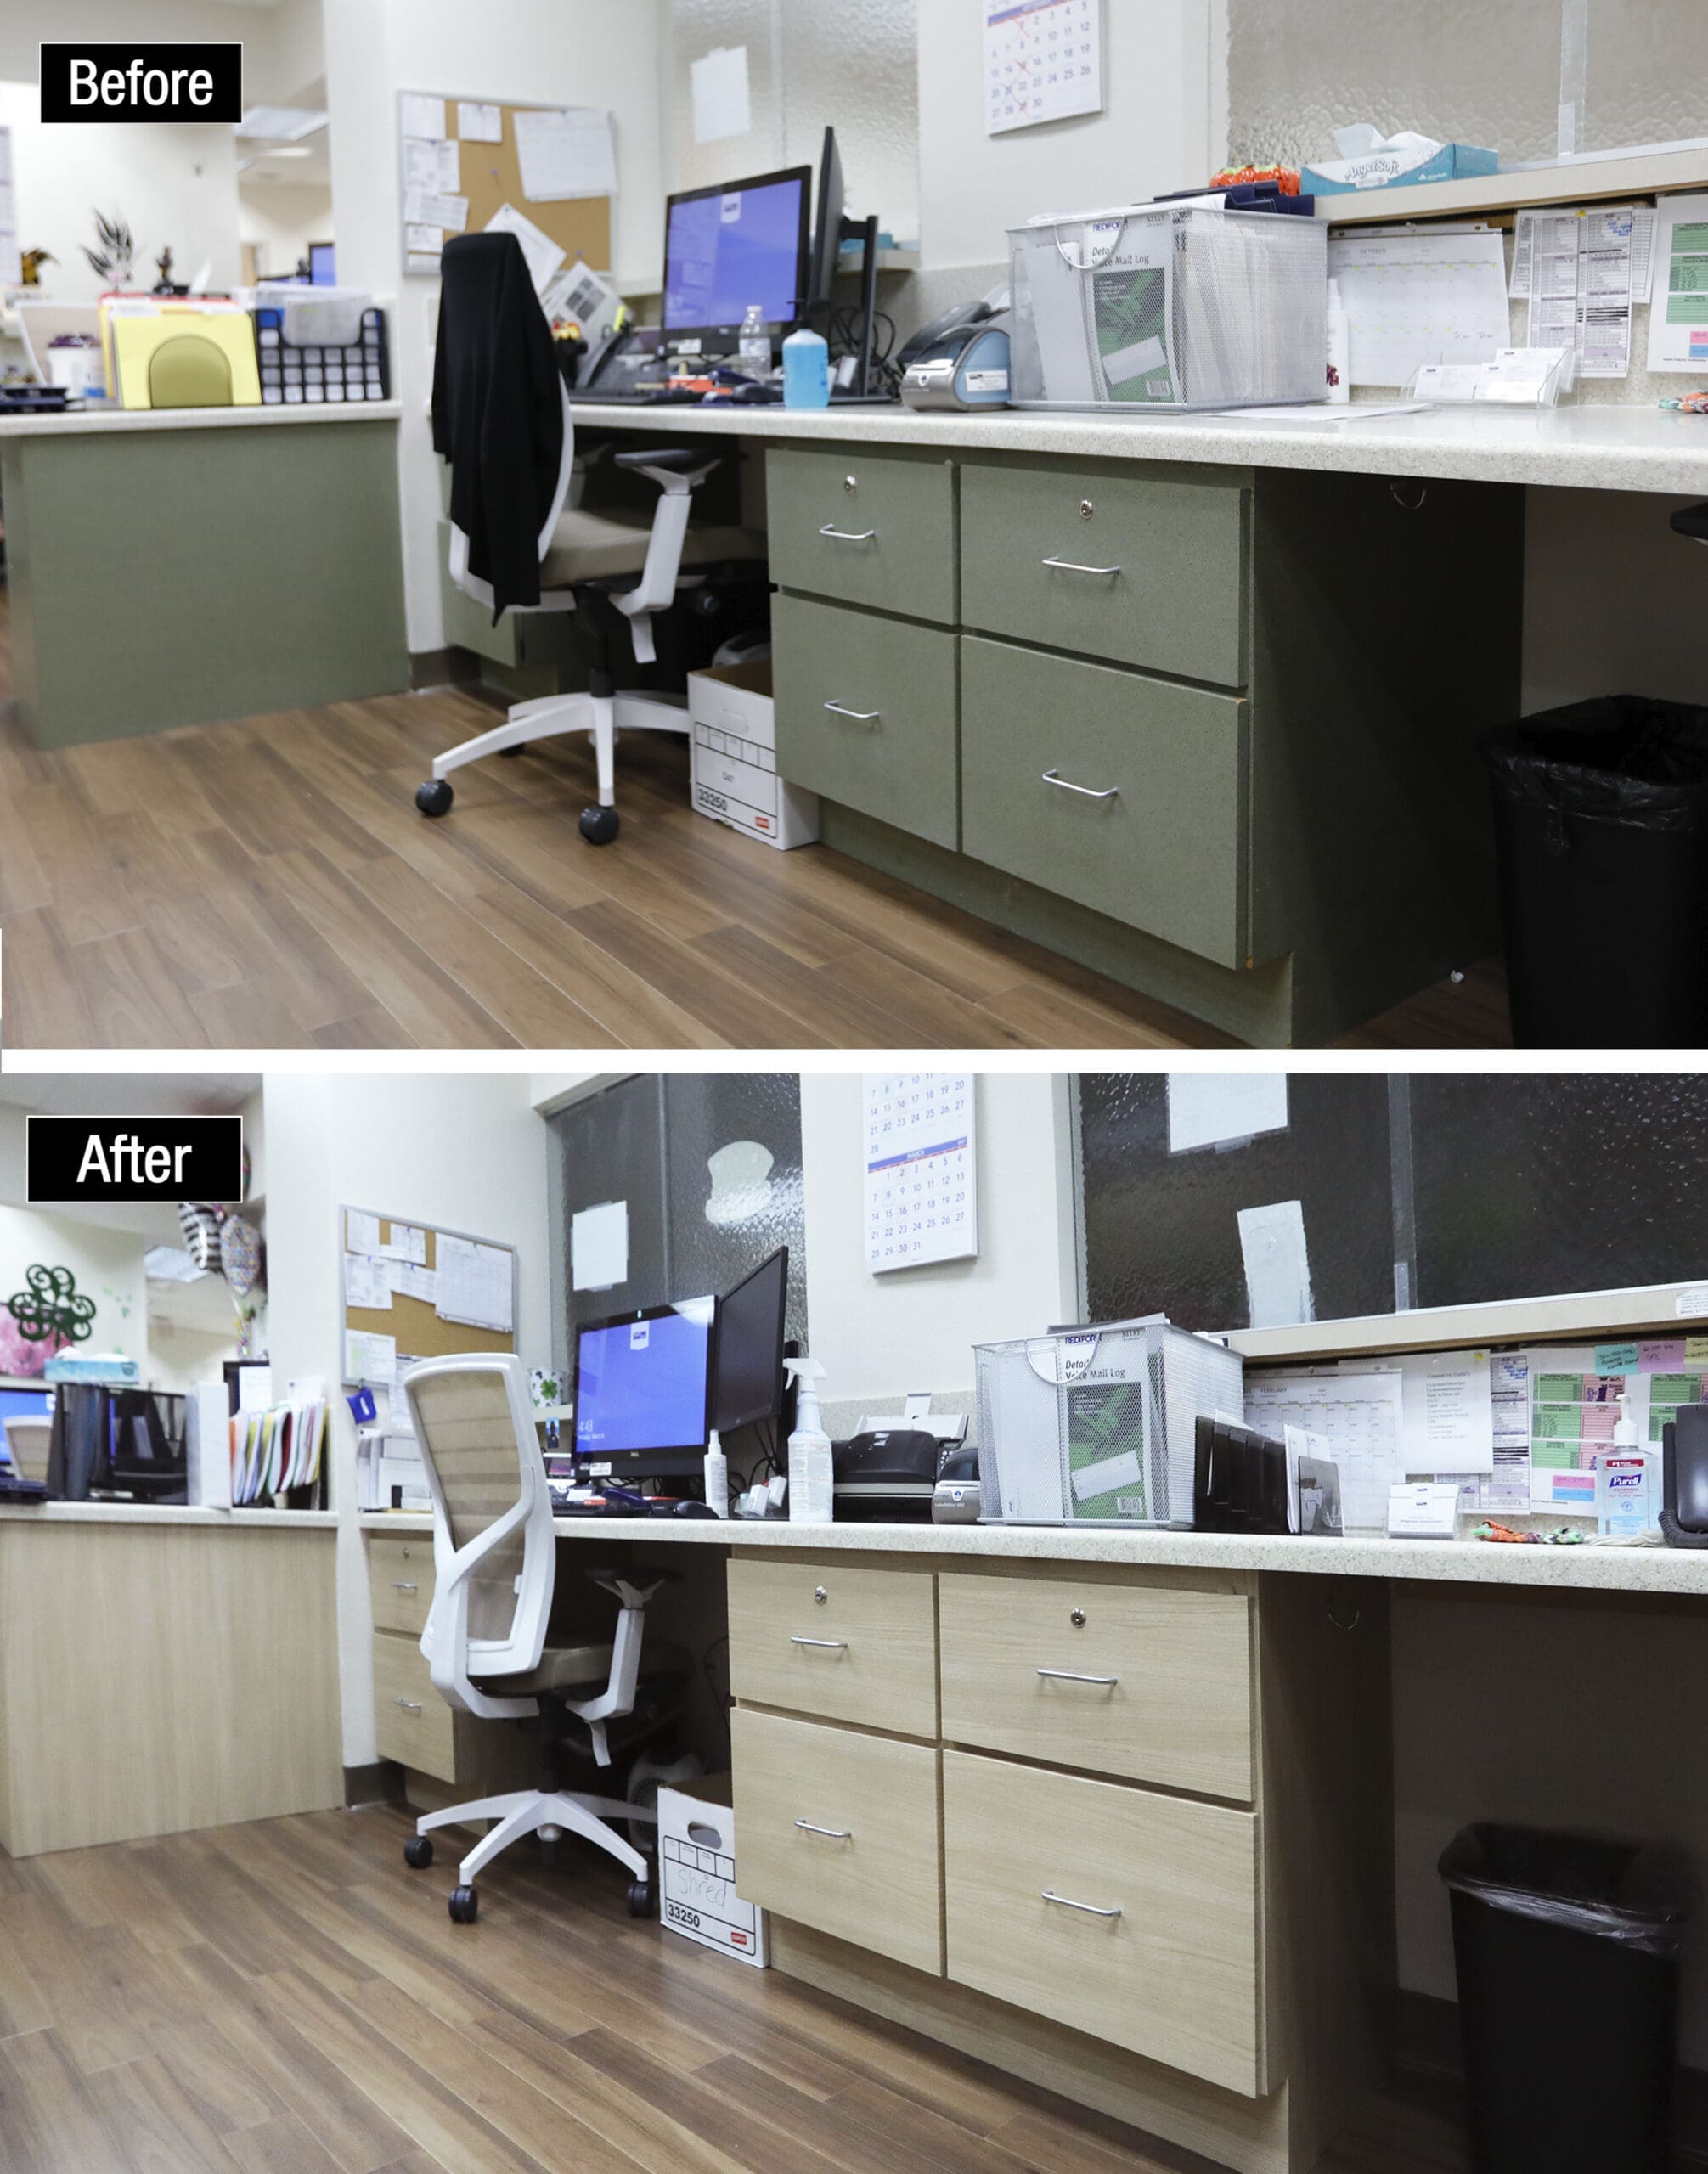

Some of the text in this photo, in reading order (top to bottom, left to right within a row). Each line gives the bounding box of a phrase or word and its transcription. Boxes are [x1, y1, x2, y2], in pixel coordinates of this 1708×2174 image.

[1115, 255, 1133, 266] Mail
[1135, 253, 1149, 266] Log
[697, 788, 728, 812] 33250
[871, 1080, 965, 1116] 14 15 16 17 18 19 20
[871, 1100, 965, 1135] 21 22 23 24 25 26 27
[871, 1144, 879, 1154] 28
[873, 1172, 965, 1202] 7 8 9 10 11 12 13
[871, 1191, 965, 1221] 14 15 16 17 18 19 20
[871, 1212, 964, 1240] 21 22 23 24 25 26 27
[871, 1241, 921, 1259] 28 29 30 31
[1090, 1368, 1108, 1379] Mail
[1110, 1368, 1126, 1379] Log
[1613, 1476, 1639, 1486] Purell
[677, 1868, 727, 1907] Shred
[668, 1904, 701, 1929] 33250
